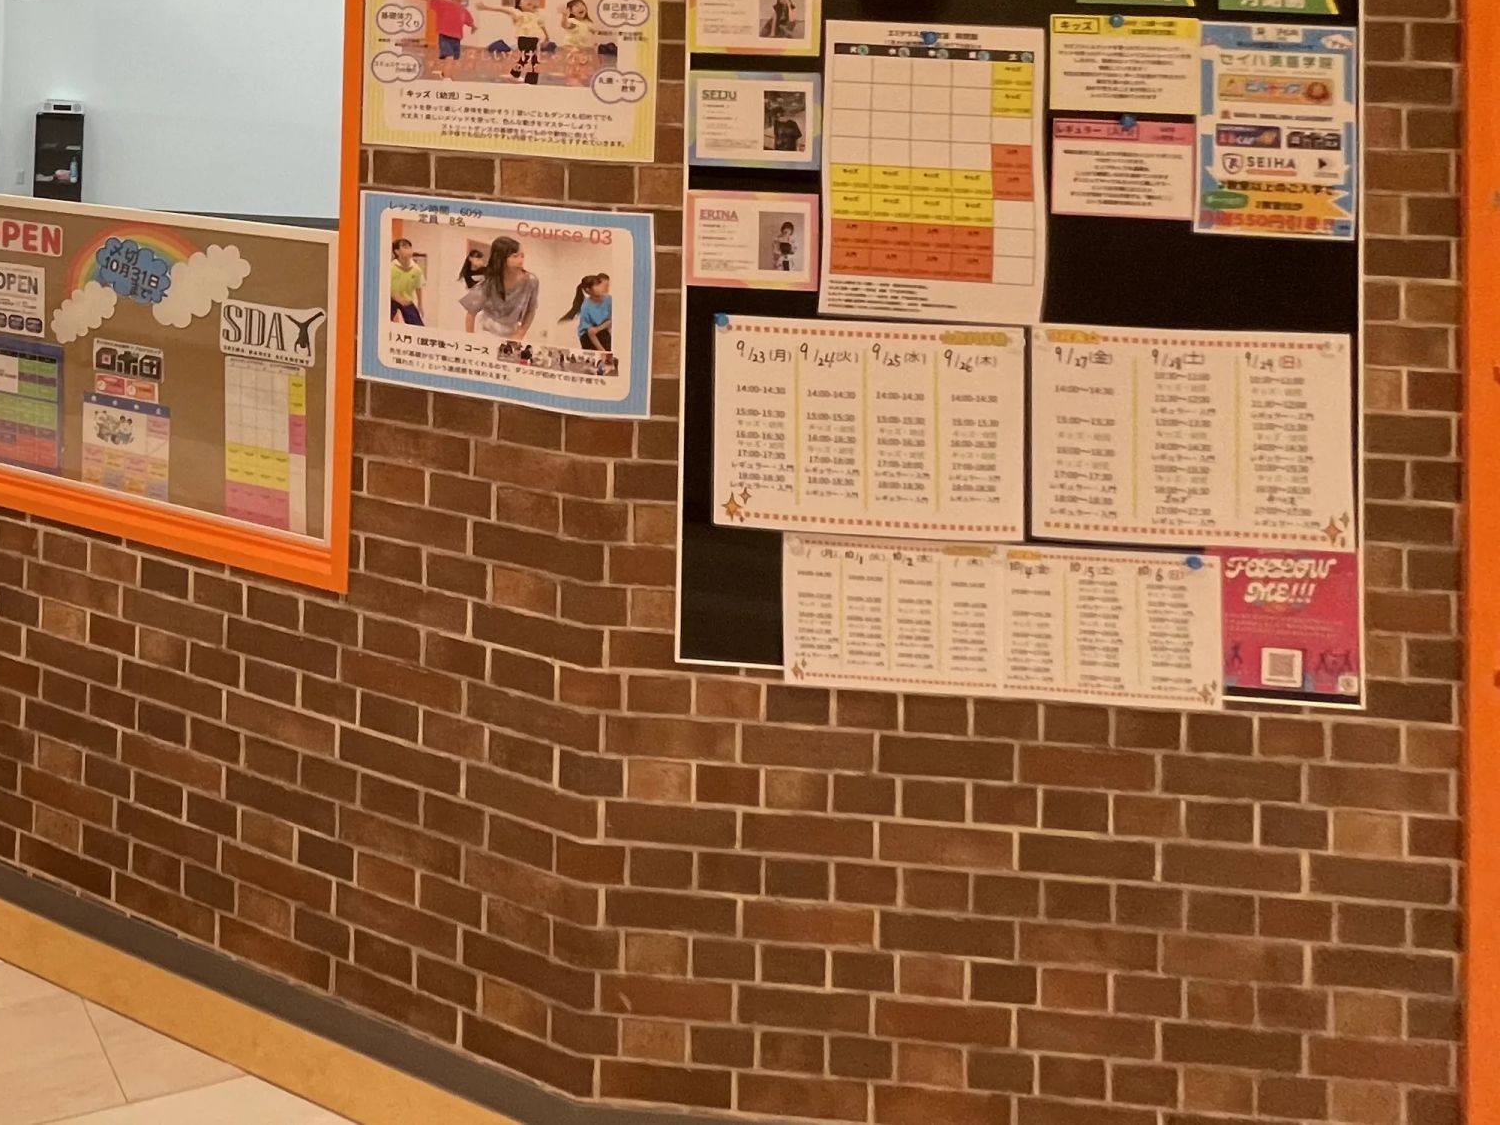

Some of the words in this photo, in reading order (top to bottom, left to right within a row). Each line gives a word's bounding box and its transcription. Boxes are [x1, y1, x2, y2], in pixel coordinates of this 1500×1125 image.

[1060, 20, 1092, 31] キッズ
[406, 90, 431, 99] キッズ
[465, 93, 490, 101] コース
[1247, 156, 1296, 169] SEIHA
[517, 221, 583, 242] Course
[590, 228, 613, 245] 03
[101, 256, 160, 290] 10月31日
[222, 304, 286, 352] SDA
[396, 333, 412, 344] 入門
[464, 343, 489, 355] コース
